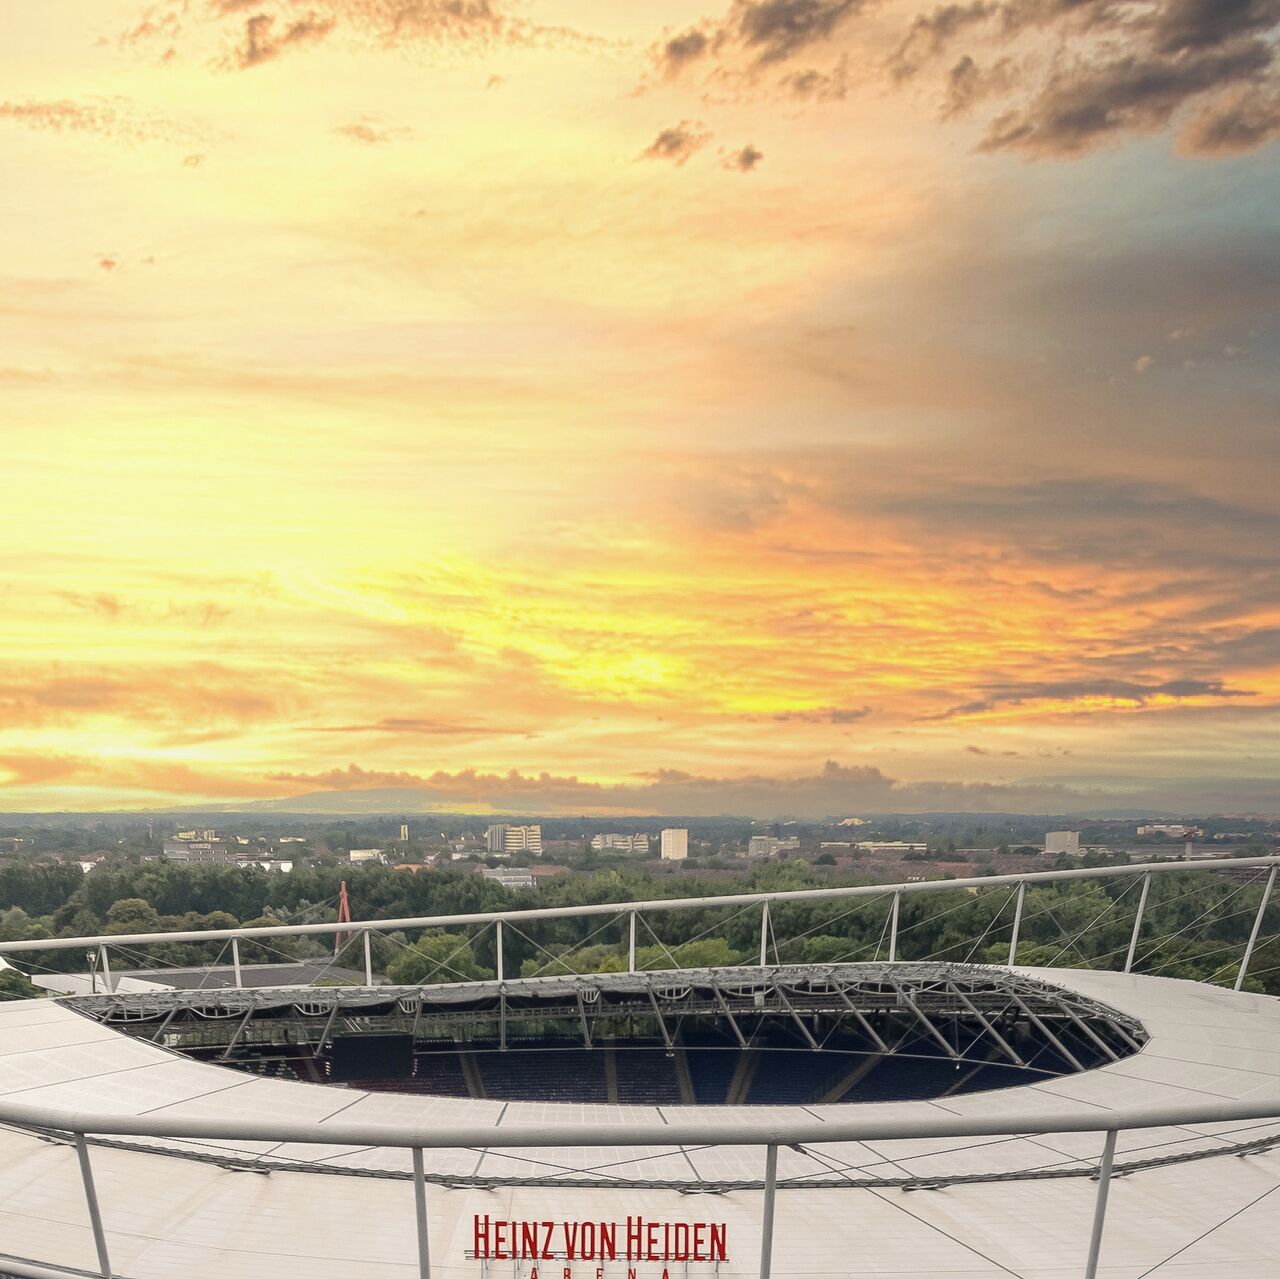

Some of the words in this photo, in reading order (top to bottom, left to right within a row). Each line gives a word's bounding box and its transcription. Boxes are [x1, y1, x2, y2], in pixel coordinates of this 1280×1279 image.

[474, 1215, 554, 1260] HEINZ
[564, 1222, 616, 1260] VON
[627, 1216, 726, 1261] HEIDEN
